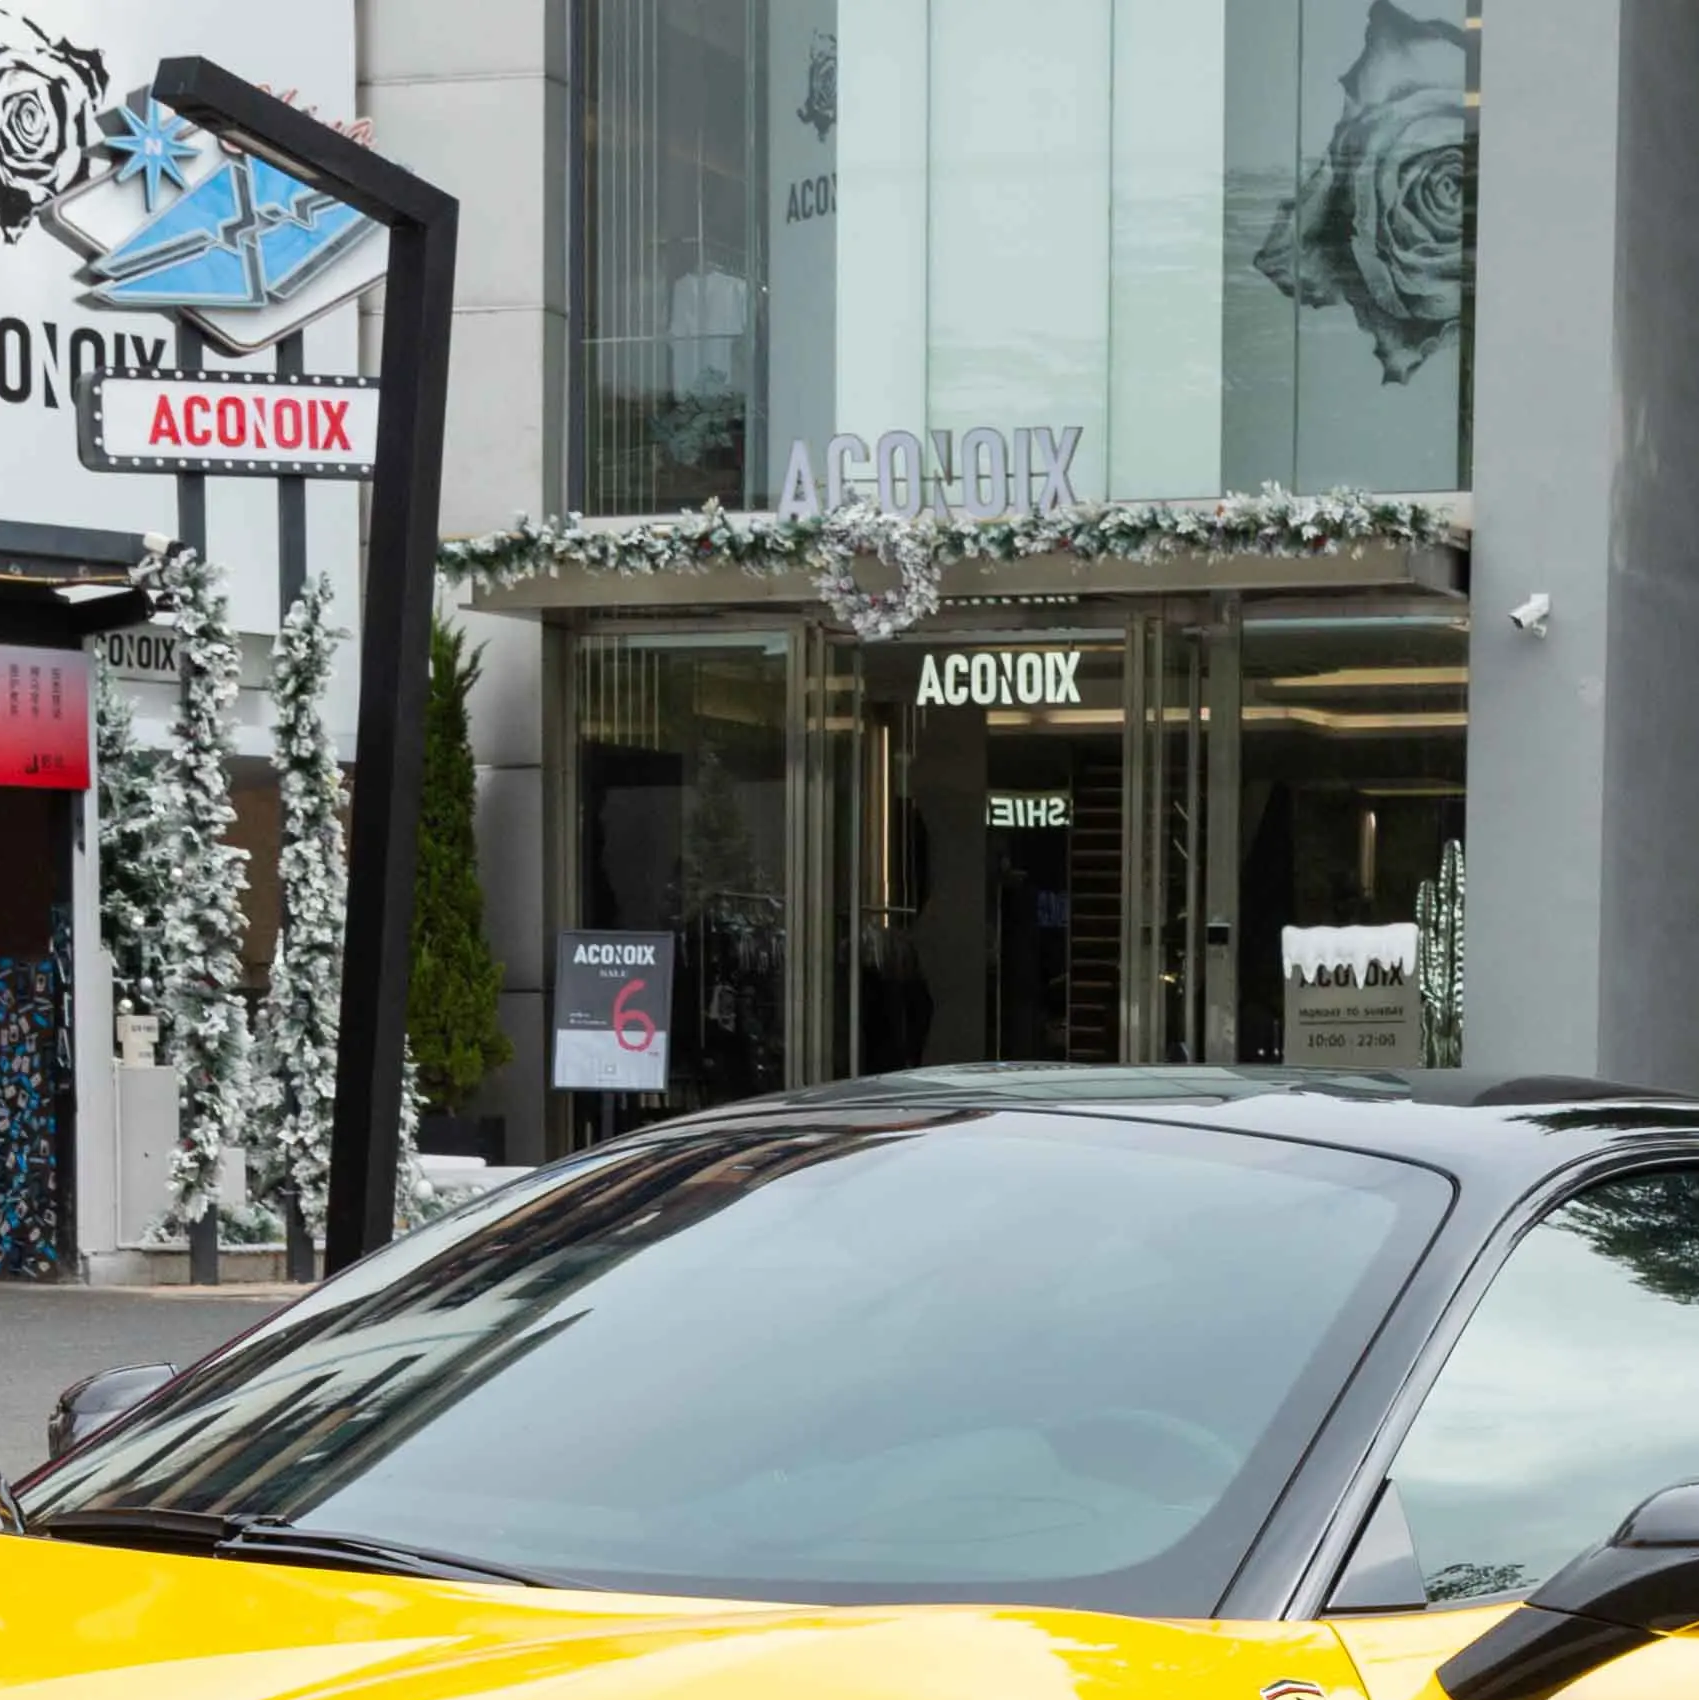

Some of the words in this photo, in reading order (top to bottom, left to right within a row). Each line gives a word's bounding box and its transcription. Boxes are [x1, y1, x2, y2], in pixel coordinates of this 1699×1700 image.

[149, 394, 352, 451] ACONOIX
[777, 426, 1084, 521] ACONOIX
[916, 651, 1082, 706] ACONOIX
[573, 943, 656, 965] ACONOIX
